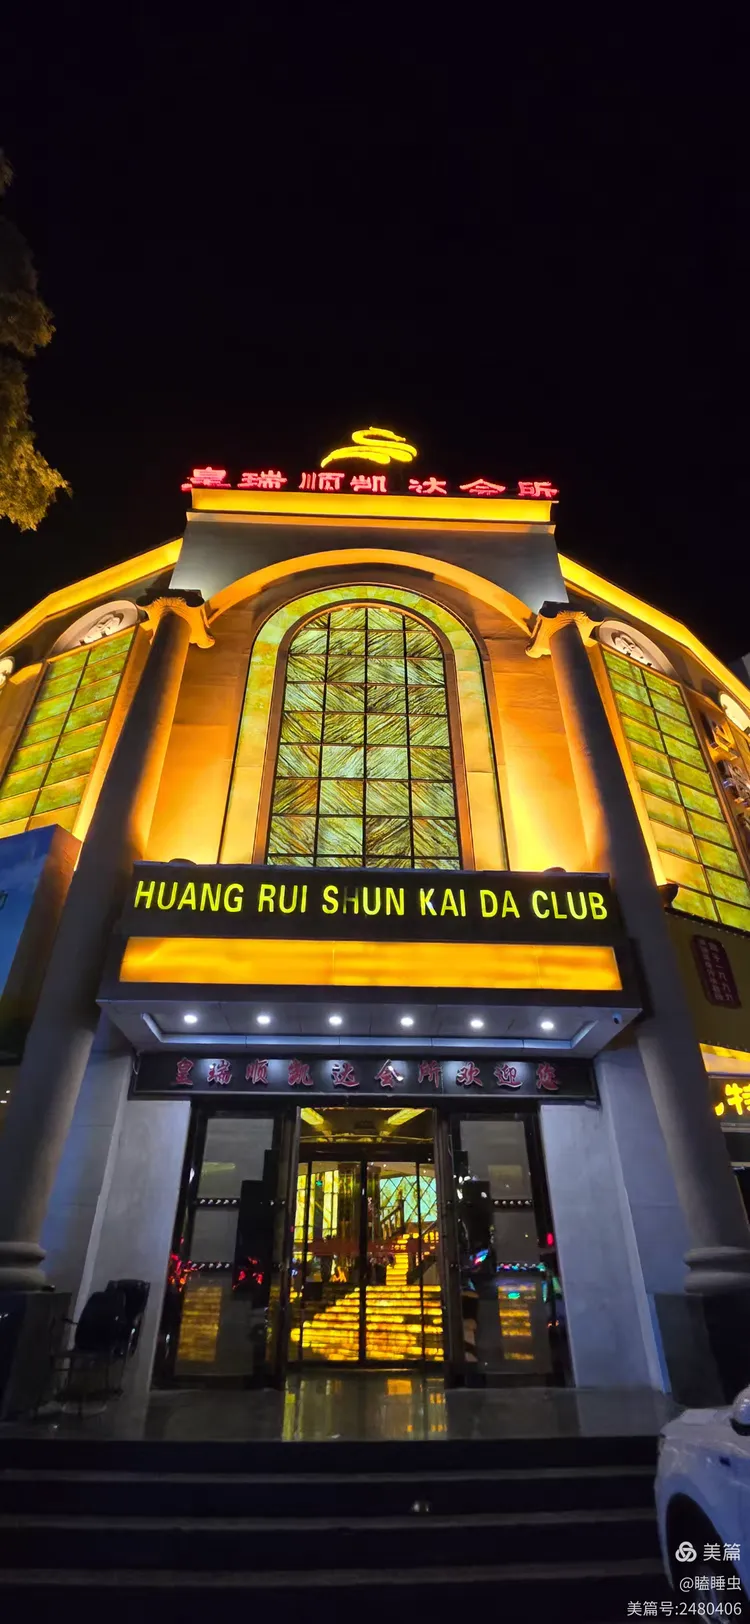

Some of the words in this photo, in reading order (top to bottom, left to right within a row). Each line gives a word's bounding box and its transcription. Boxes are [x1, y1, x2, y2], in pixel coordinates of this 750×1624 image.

[133, 880, 245, 913] HUANG
[257, 884, 309, 914] RUI
[322, 885, 406, 916] SHUN
[419, 887, 467, 918] KAI
[480, 889, 521, 919] DA
[531, 891, 608, 921] CLUB
[175, 1057, 560, 1091] 皇瑞顺凯达会所欢迎您
